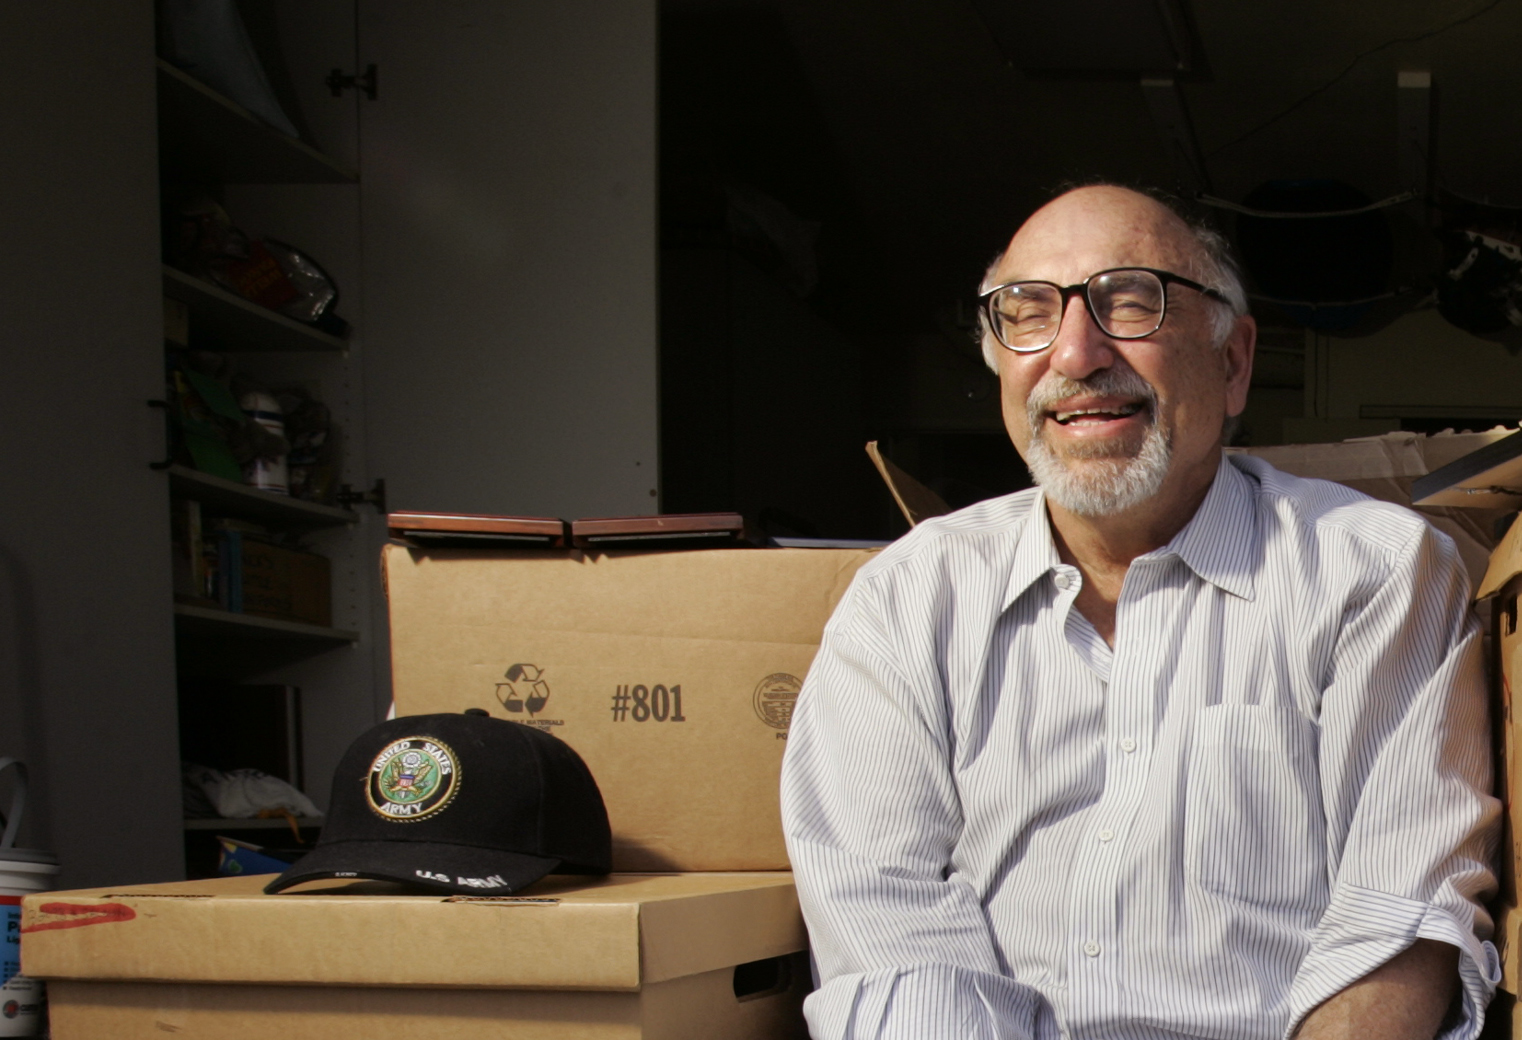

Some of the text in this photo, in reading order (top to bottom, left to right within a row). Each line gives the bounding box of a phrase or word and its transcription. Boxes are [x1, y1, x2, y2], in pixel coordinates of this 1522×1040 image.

[611, 684, 686, 722] #801
[372, 741, 452, 775] UNITED STATES
[379, 802, 423, 815] ARMY
[457, 874, 508, 889] ARMY
